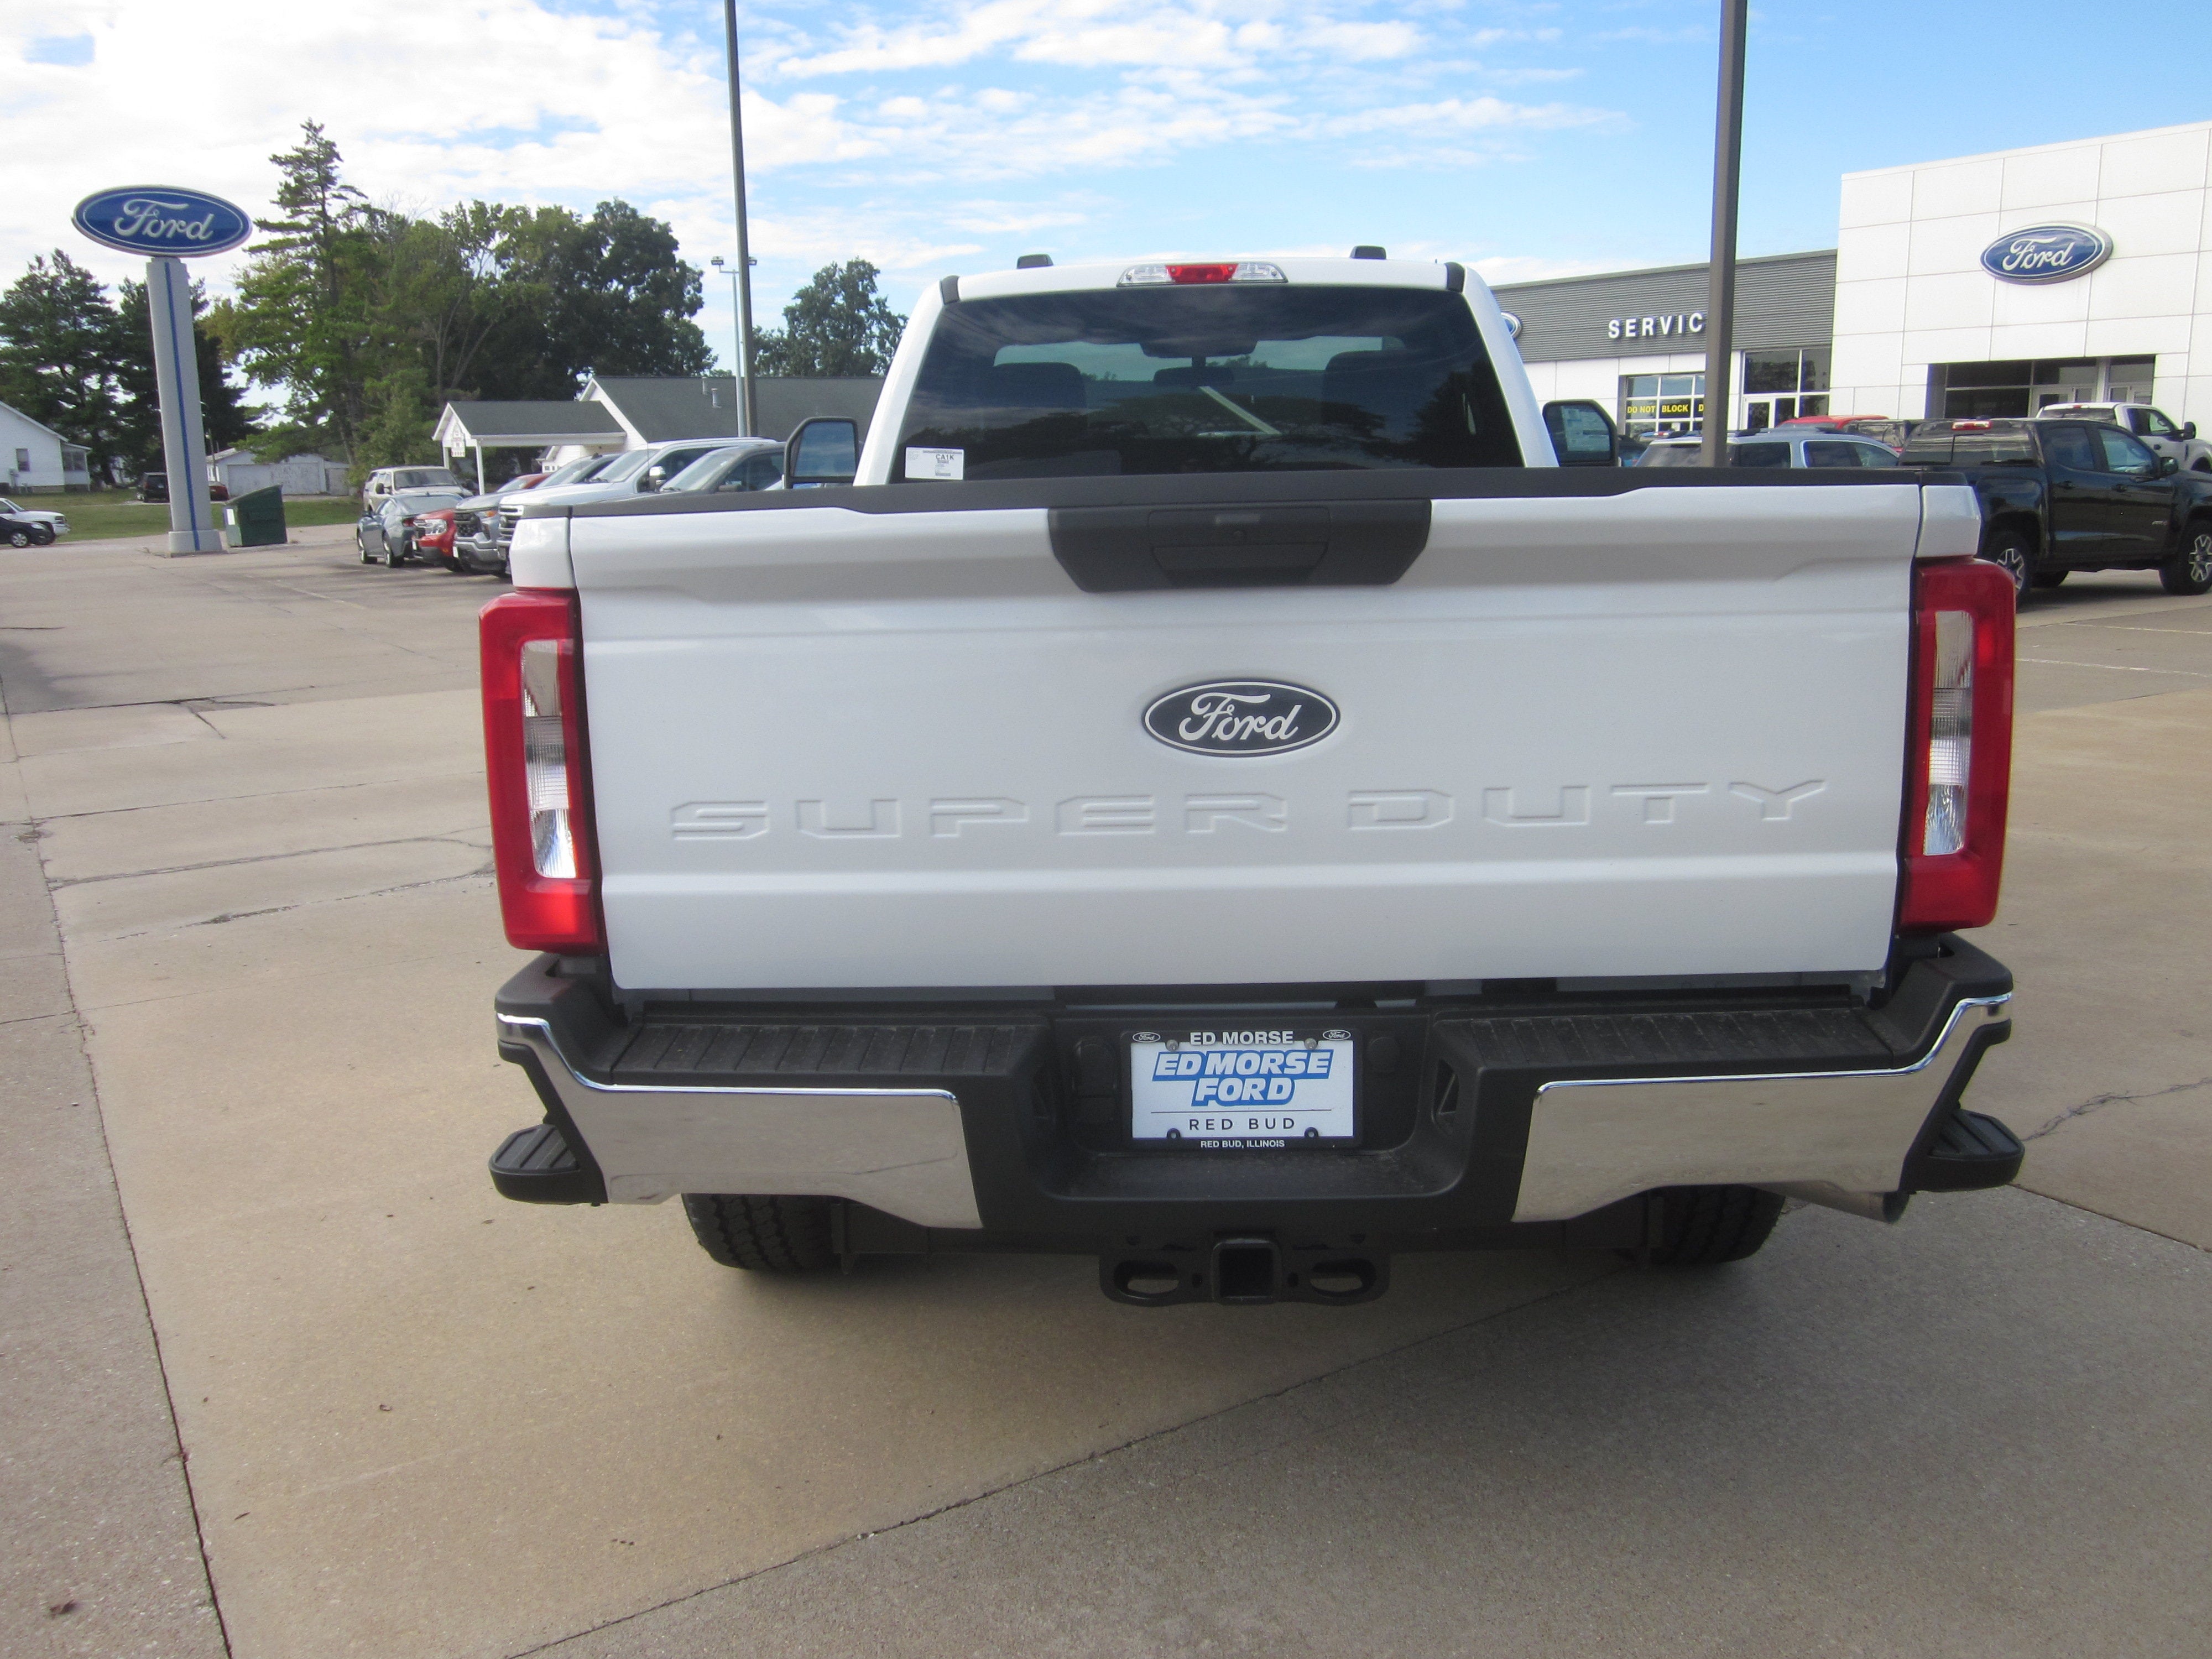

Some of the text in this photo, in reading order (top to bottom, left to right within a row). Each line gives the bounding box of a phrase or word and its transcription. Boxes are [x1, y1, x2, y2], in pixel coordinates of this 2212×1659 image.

[114, 199, 215, 240] Ford
[2002, 237, 2075, 271] Ford
[1608, 312, 1704, 338] SERVIC
[1662, 404, 1688, 413] BLOCK
[1179, 692, 1302, 740] Ford
[671, 780, 1827, 841] SUPER DUTY
[1190, 1031, 1293, 1045] ED MORSE
[1155, 1052, 1330, 1076] ED MORSE
[1195, 1077, 1293, 1102] FORD
[1190, 1118, 1295, 1130] RED BUD
[1222, 1140, 1244, 1149] BUD,
[1246, 1140, 1285, 1148] ILLINOIS
